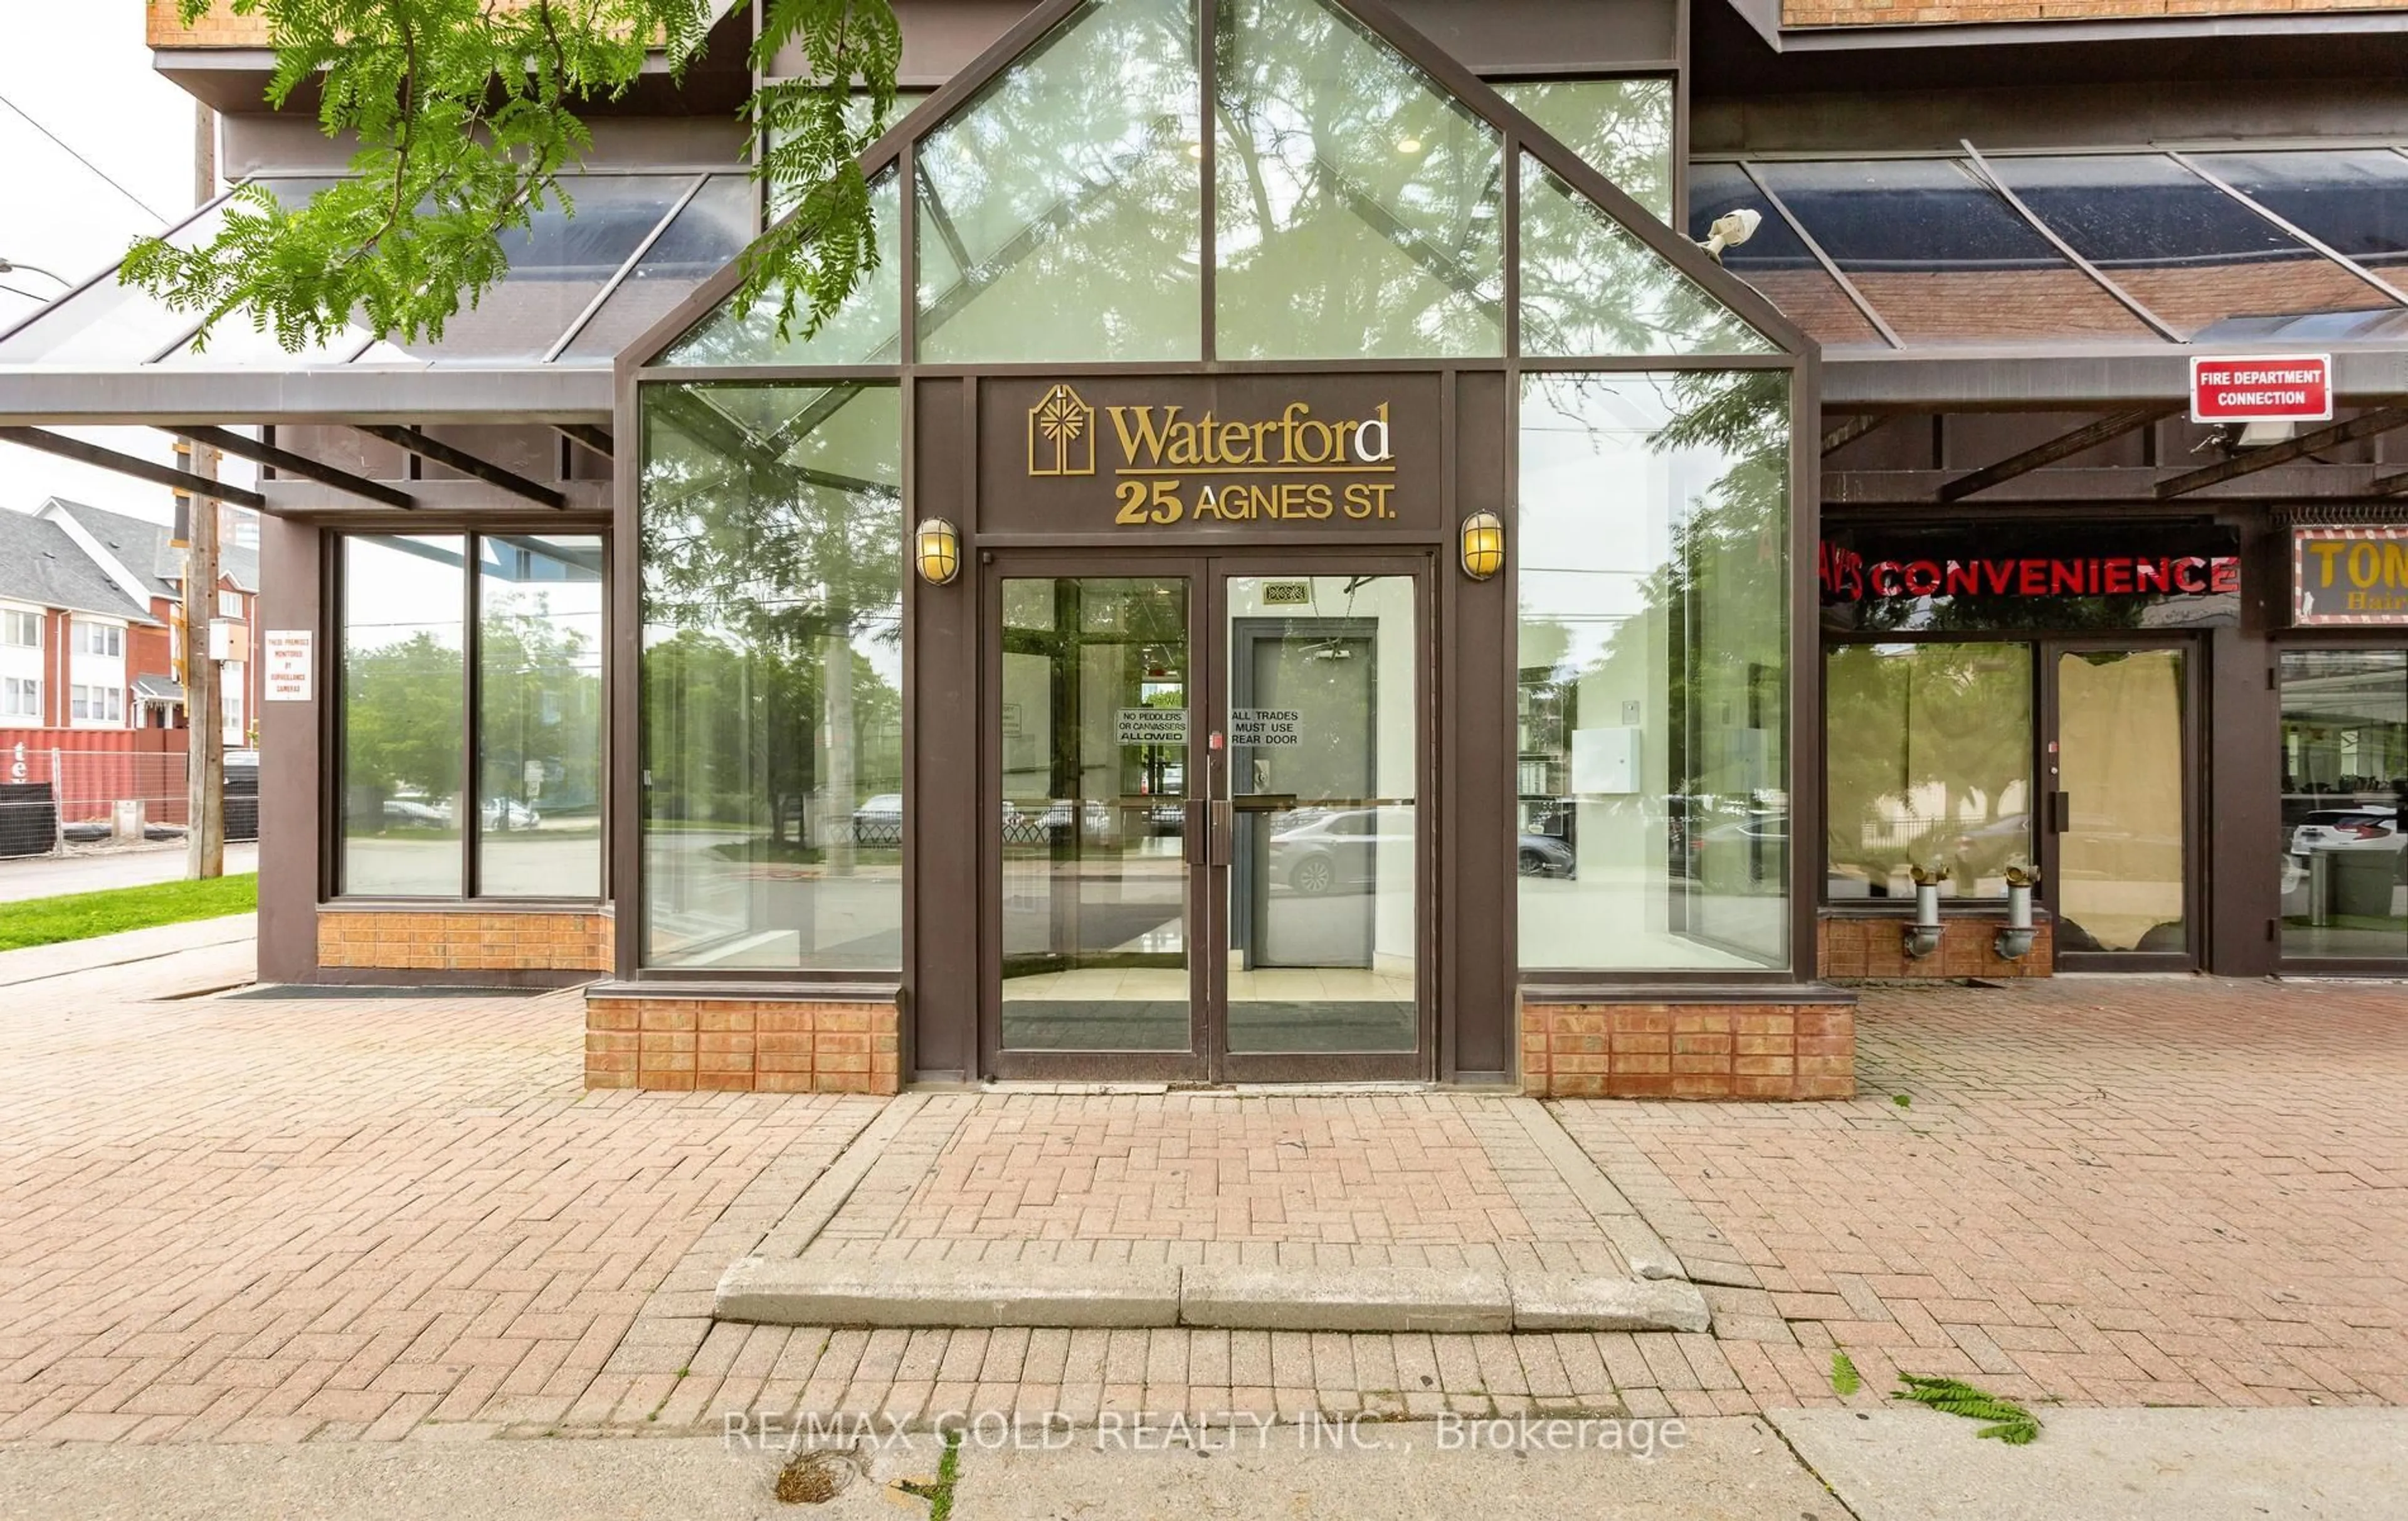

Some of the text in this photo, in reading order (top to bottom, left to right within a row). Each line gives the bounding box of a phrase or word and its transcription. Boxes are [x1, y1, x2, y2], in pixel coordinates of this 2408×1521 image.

[2200, 370, 2321, 386] FIRE DEPARTMENT
[2218, 391, 2306, 405] CONNECTION
[1106, 401, 1395, 465] Waterford
[1115, 480, 1396, 524] 25 AGNES ST.
[1871, 556, 2240, 596] CONVENIENCE
[1123, 713, 1182, 721] NO PEDDLERS
[1232, 711, 1299, 721] ALL TRADES
[1133, 723, 1186, 731] CANVASSERS
[1235, 723, 1294, 733] MUST USE
[1232, 735, 1297, 744] REAR DOOR
